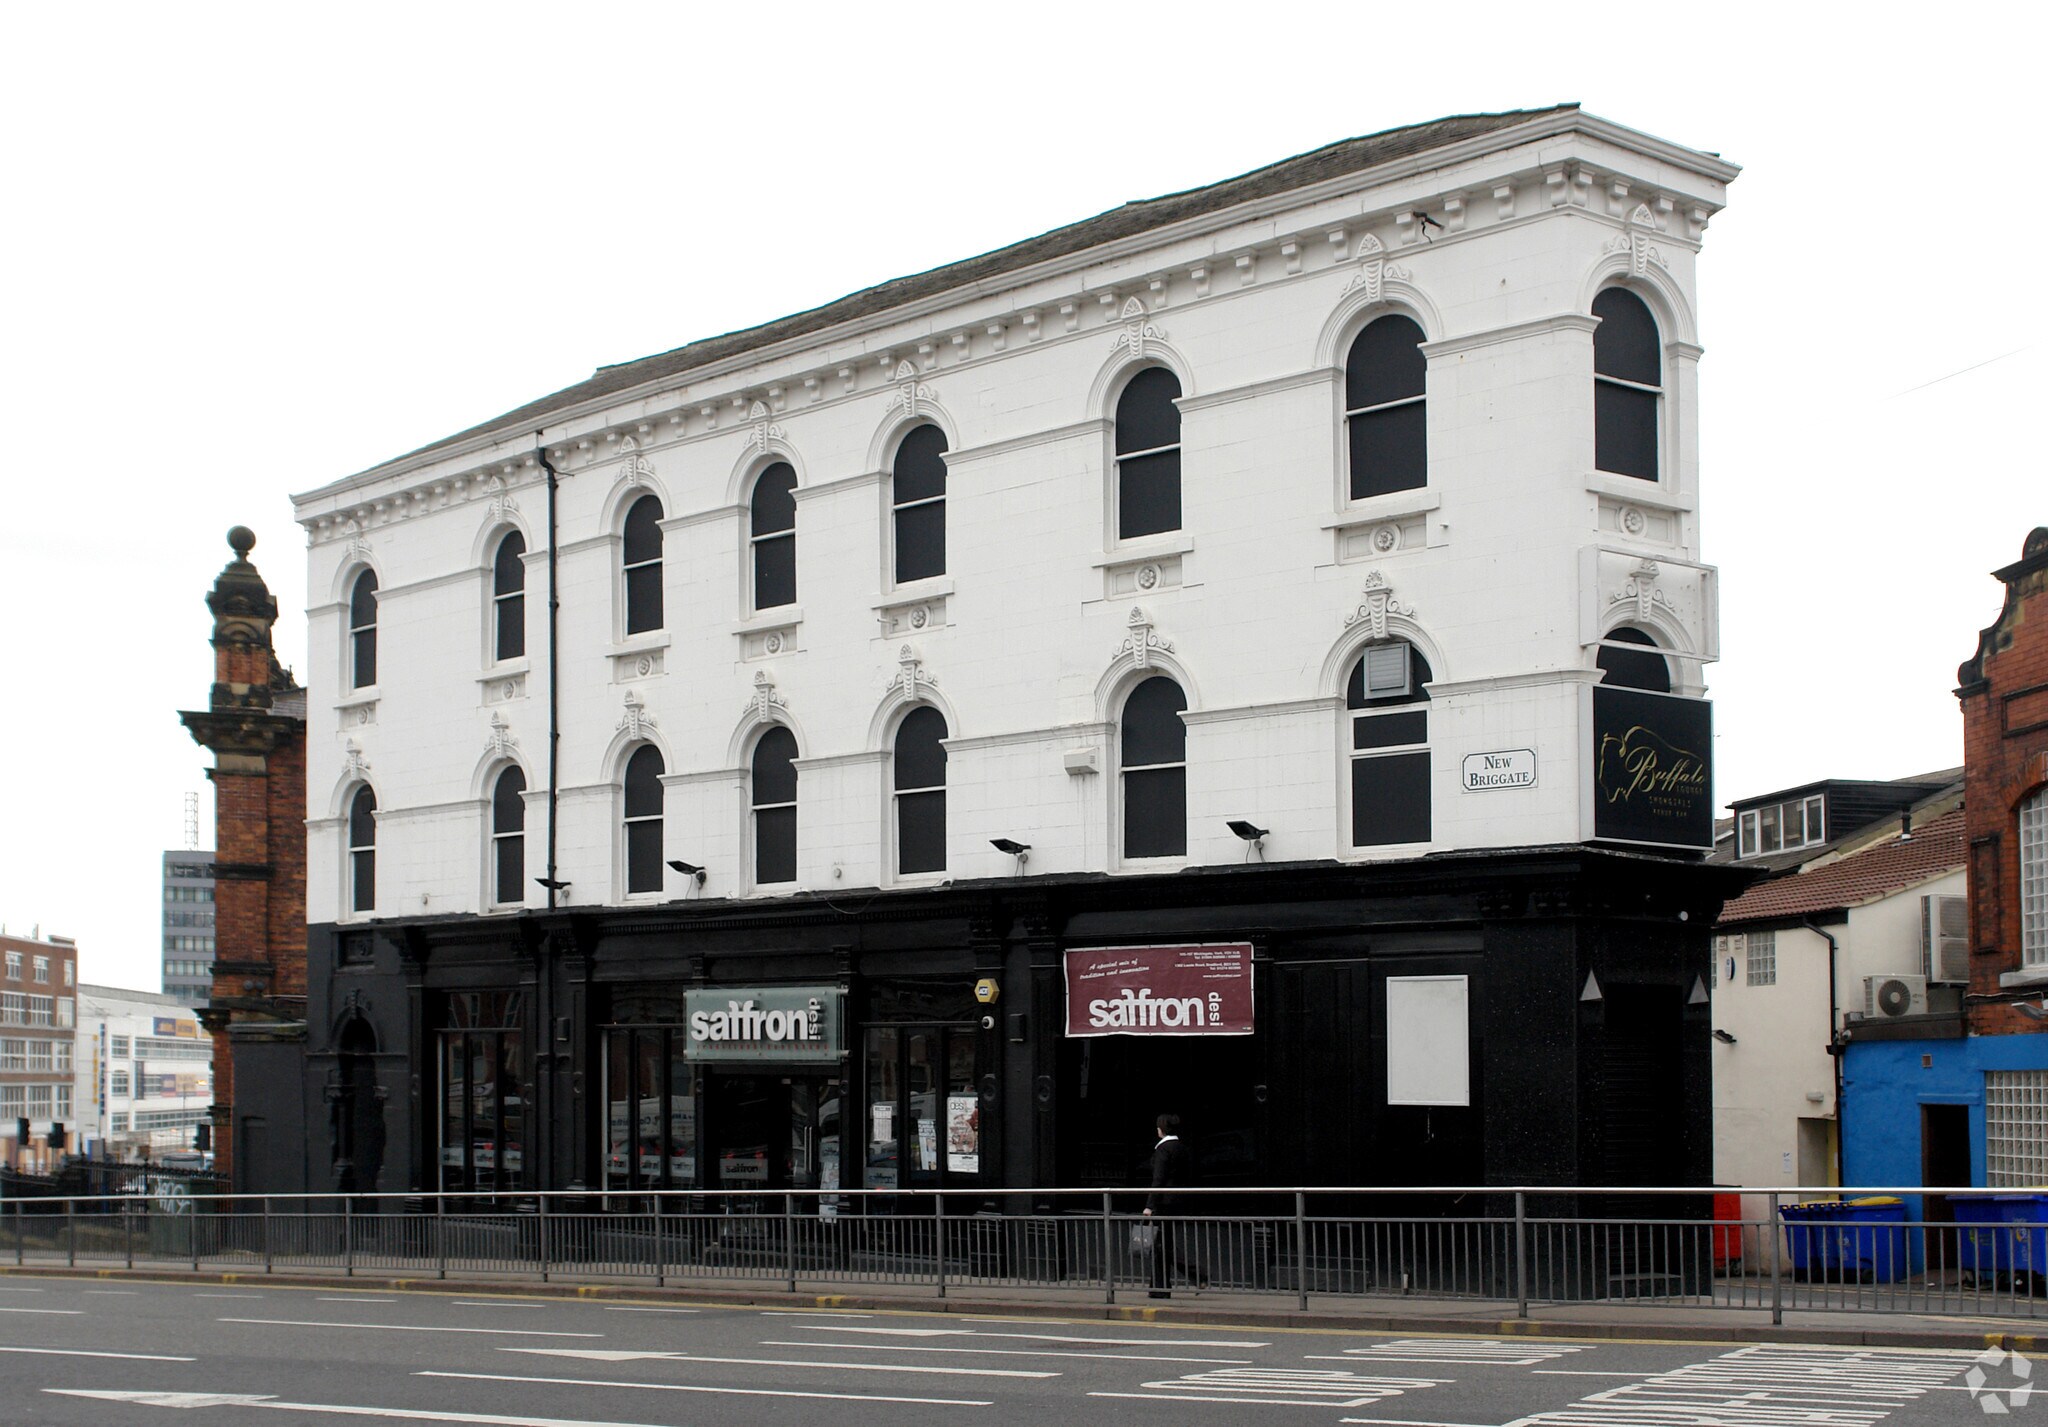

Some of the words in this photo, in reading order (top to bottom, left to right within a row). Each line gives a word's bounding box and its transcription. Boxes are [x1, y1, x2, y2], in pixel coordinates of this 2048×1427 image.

[1469, 772, 1530, 786] BRIGGATE
[1625, 746, 1705, 801] Buffalo
[1097, 961, 1117, 970] special
[1119, 966, 1150, 974] innovation
[691, 999, 809, 1042] saffron
[808, 997, 822, 1041] desi
[1089, 988, 1205, 1028] saffron
[1208, 991, 1224, 1027] desi
[725, 1163, 759, 1174] saffron
